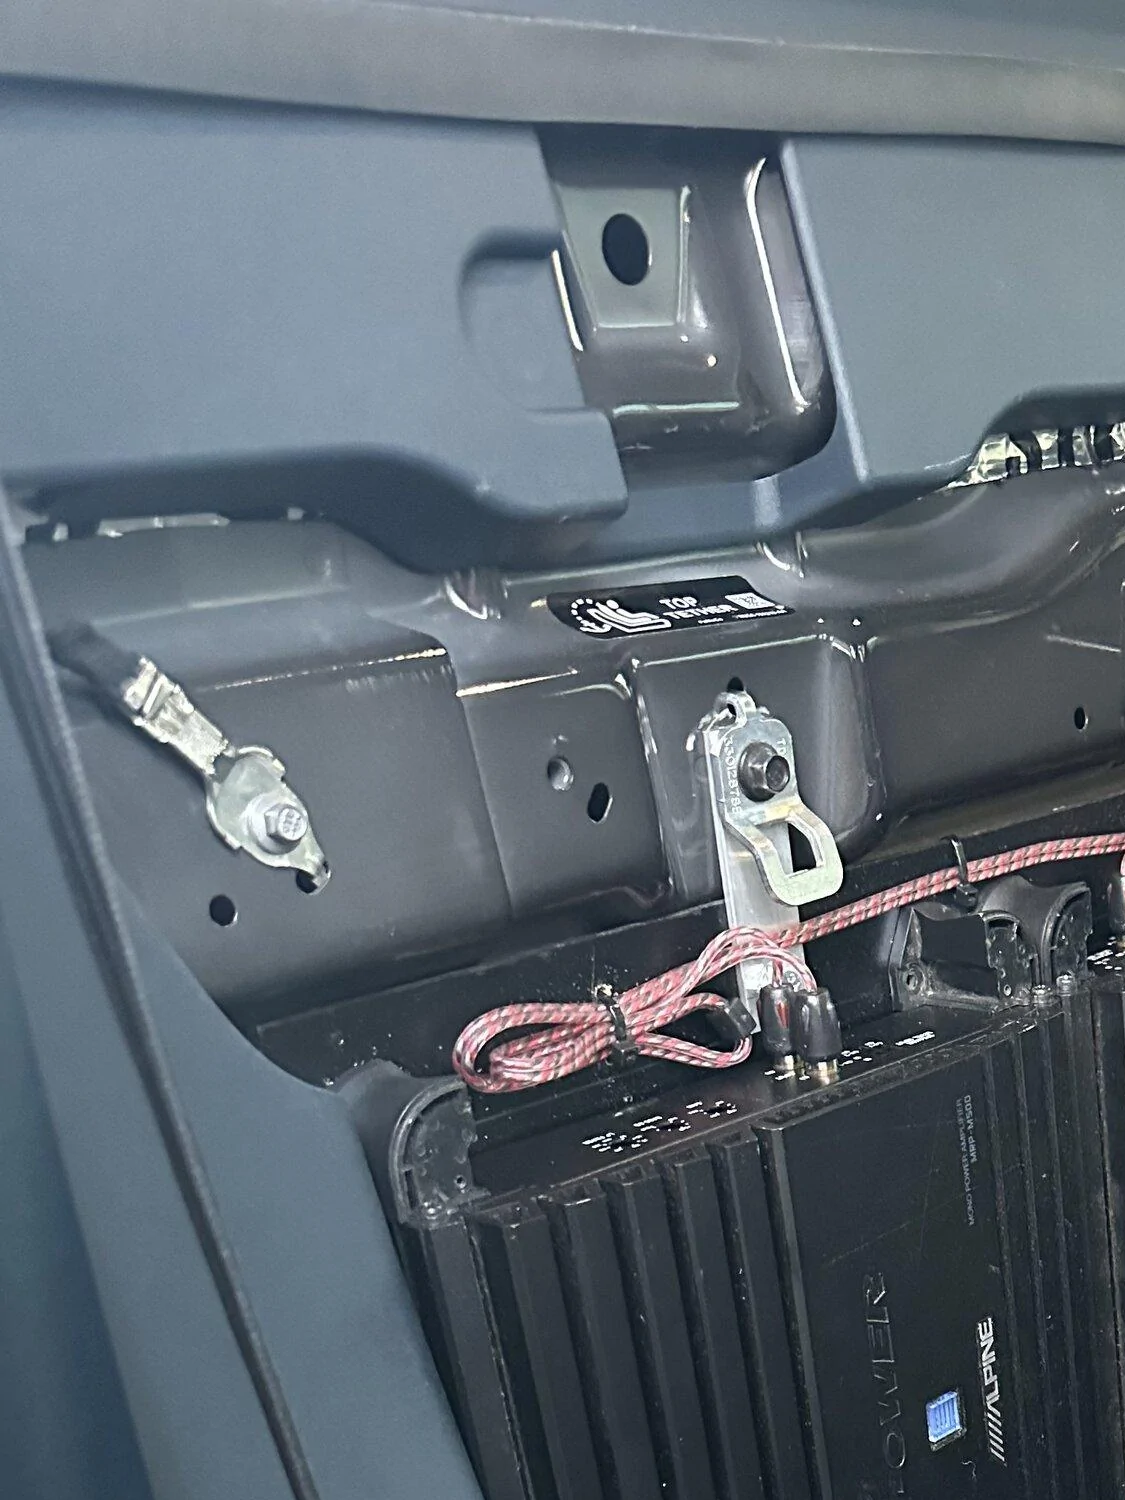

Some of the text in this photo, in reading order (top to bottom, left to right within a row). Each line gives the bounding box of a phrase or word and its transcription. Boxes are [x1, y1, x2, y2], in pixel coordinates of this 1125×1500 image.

[659, 596, 698, 610] TOP
[662, 604, 738, 620] TETHER
[956, 1098, 976, 1226] MONO POWER AMPLIFIER
